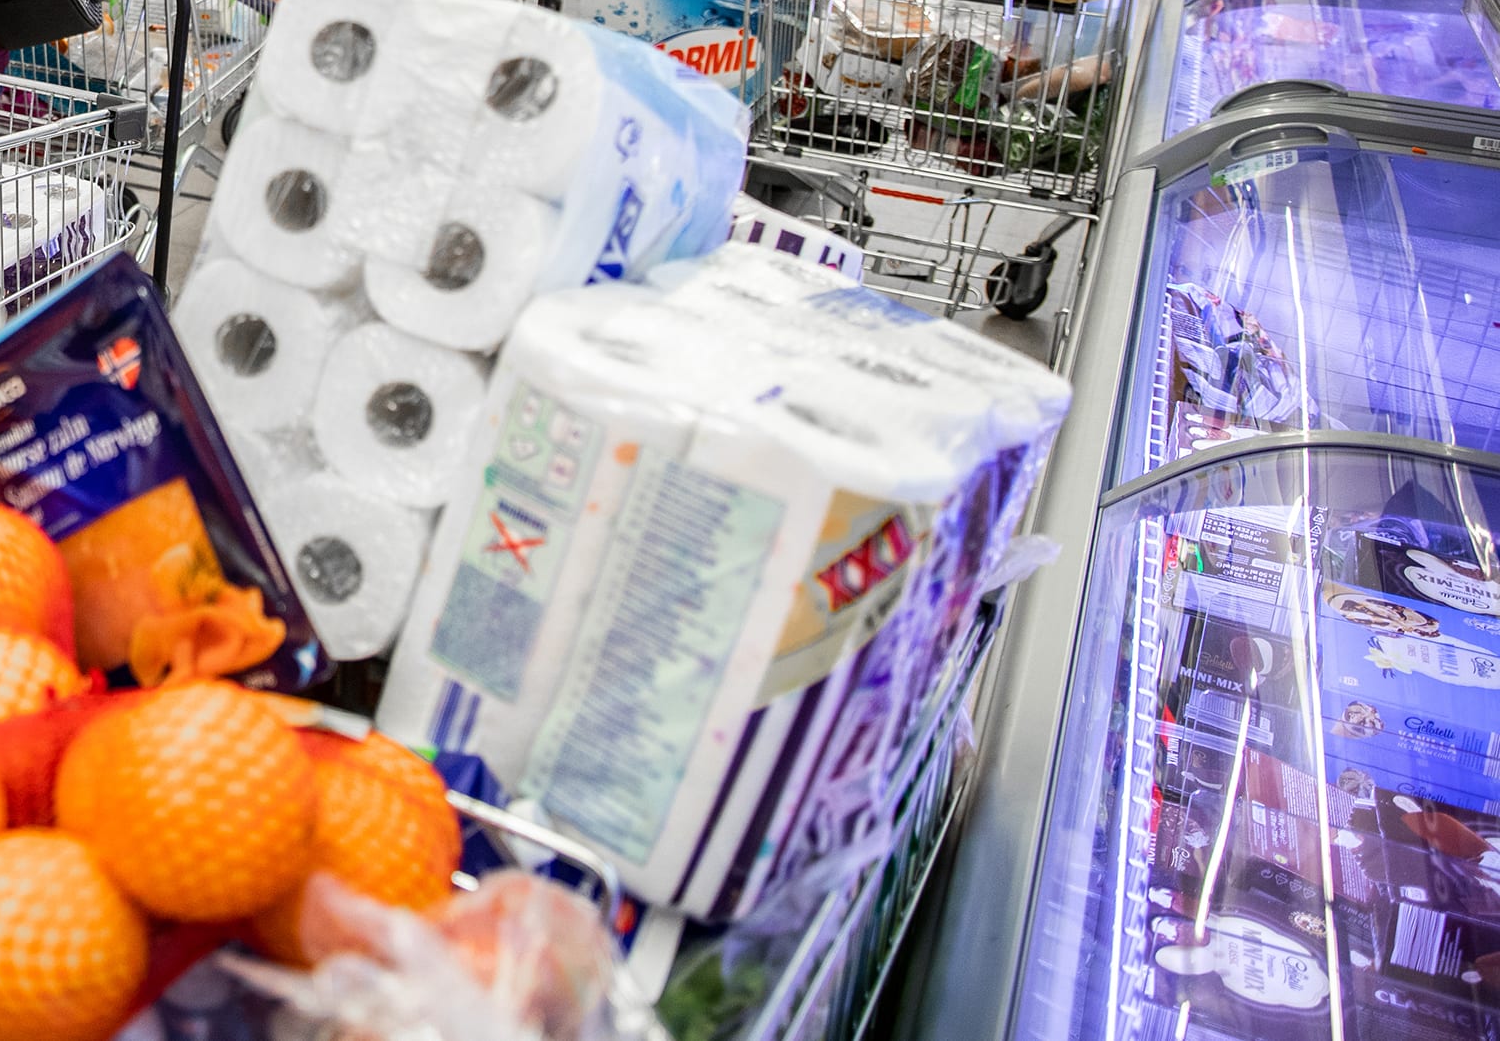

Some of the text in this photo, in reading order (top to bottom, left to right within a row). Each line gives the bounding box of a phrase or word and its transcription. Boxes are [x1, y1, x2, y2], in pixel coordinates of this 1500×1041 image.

[1180, 666, 1244, 693] MINI-MIX
[1404, 716, 1456, 740] Gelatelli
[1242, 926, 1265, 994] MINI-MIX
[1374, 989, 1472, 1028] CLASSIC
